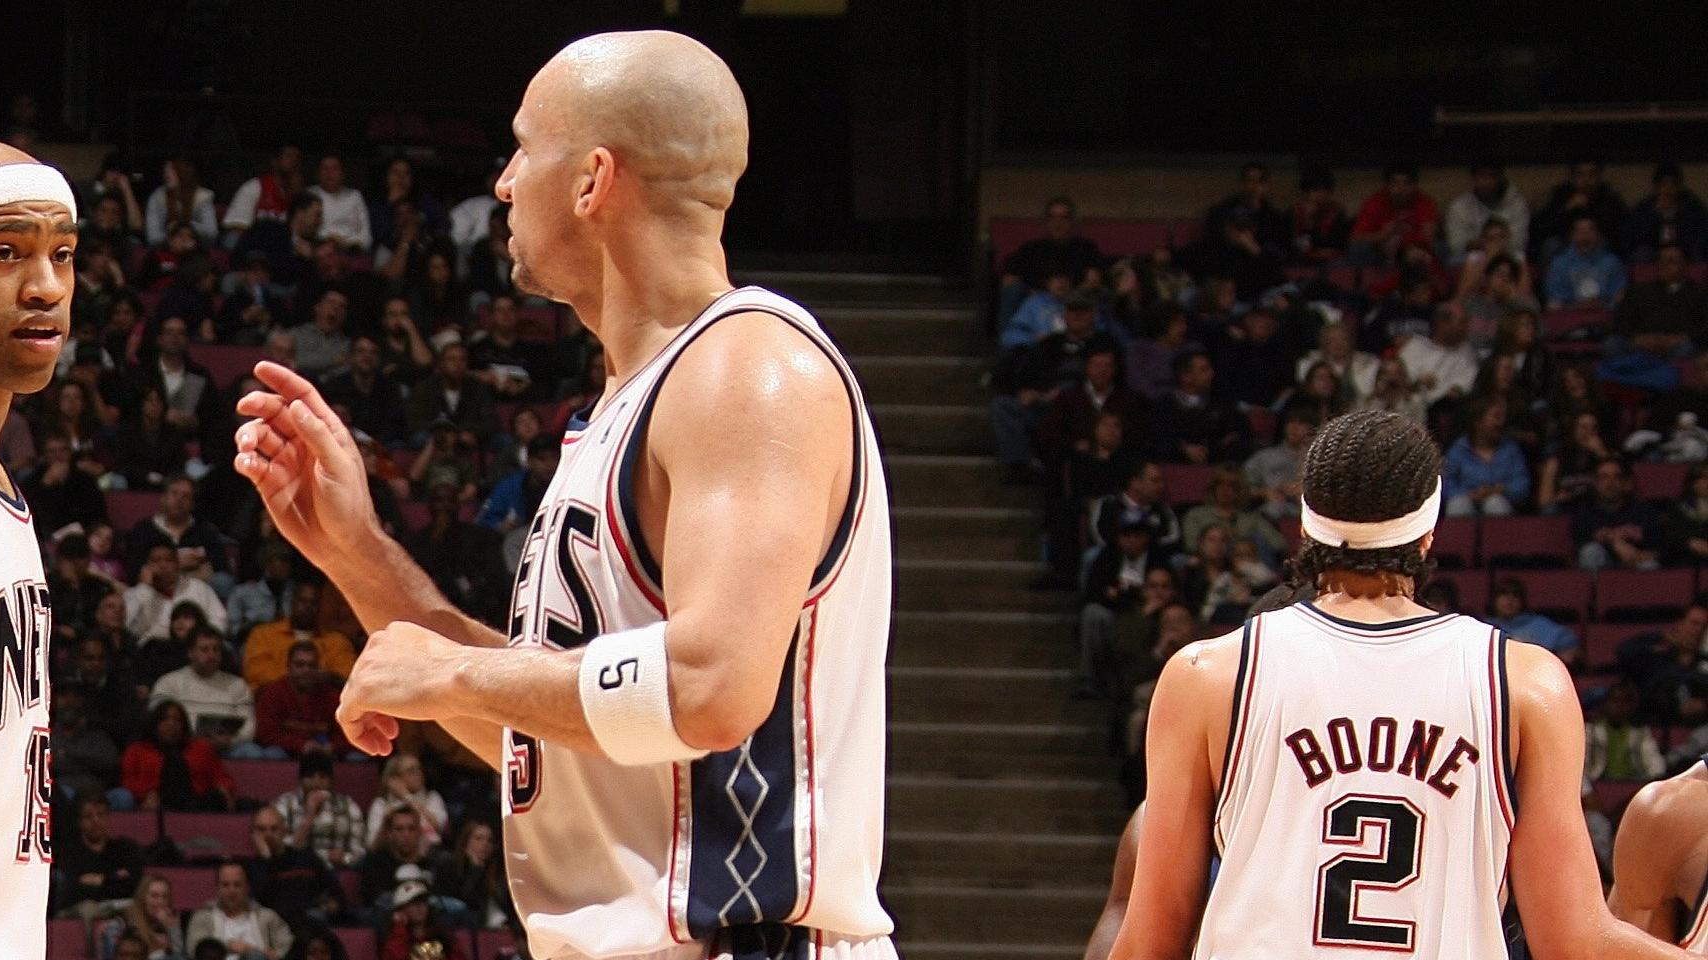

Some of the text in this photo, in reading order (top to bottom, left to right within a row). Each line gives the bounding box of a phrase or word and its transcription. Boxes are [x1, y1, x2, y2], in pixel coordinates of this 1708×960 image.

[599, 657, 638, 690] 5
[1285, 717, 1480, 799] BOONE
[1313, 793, 1426, 952] 2
